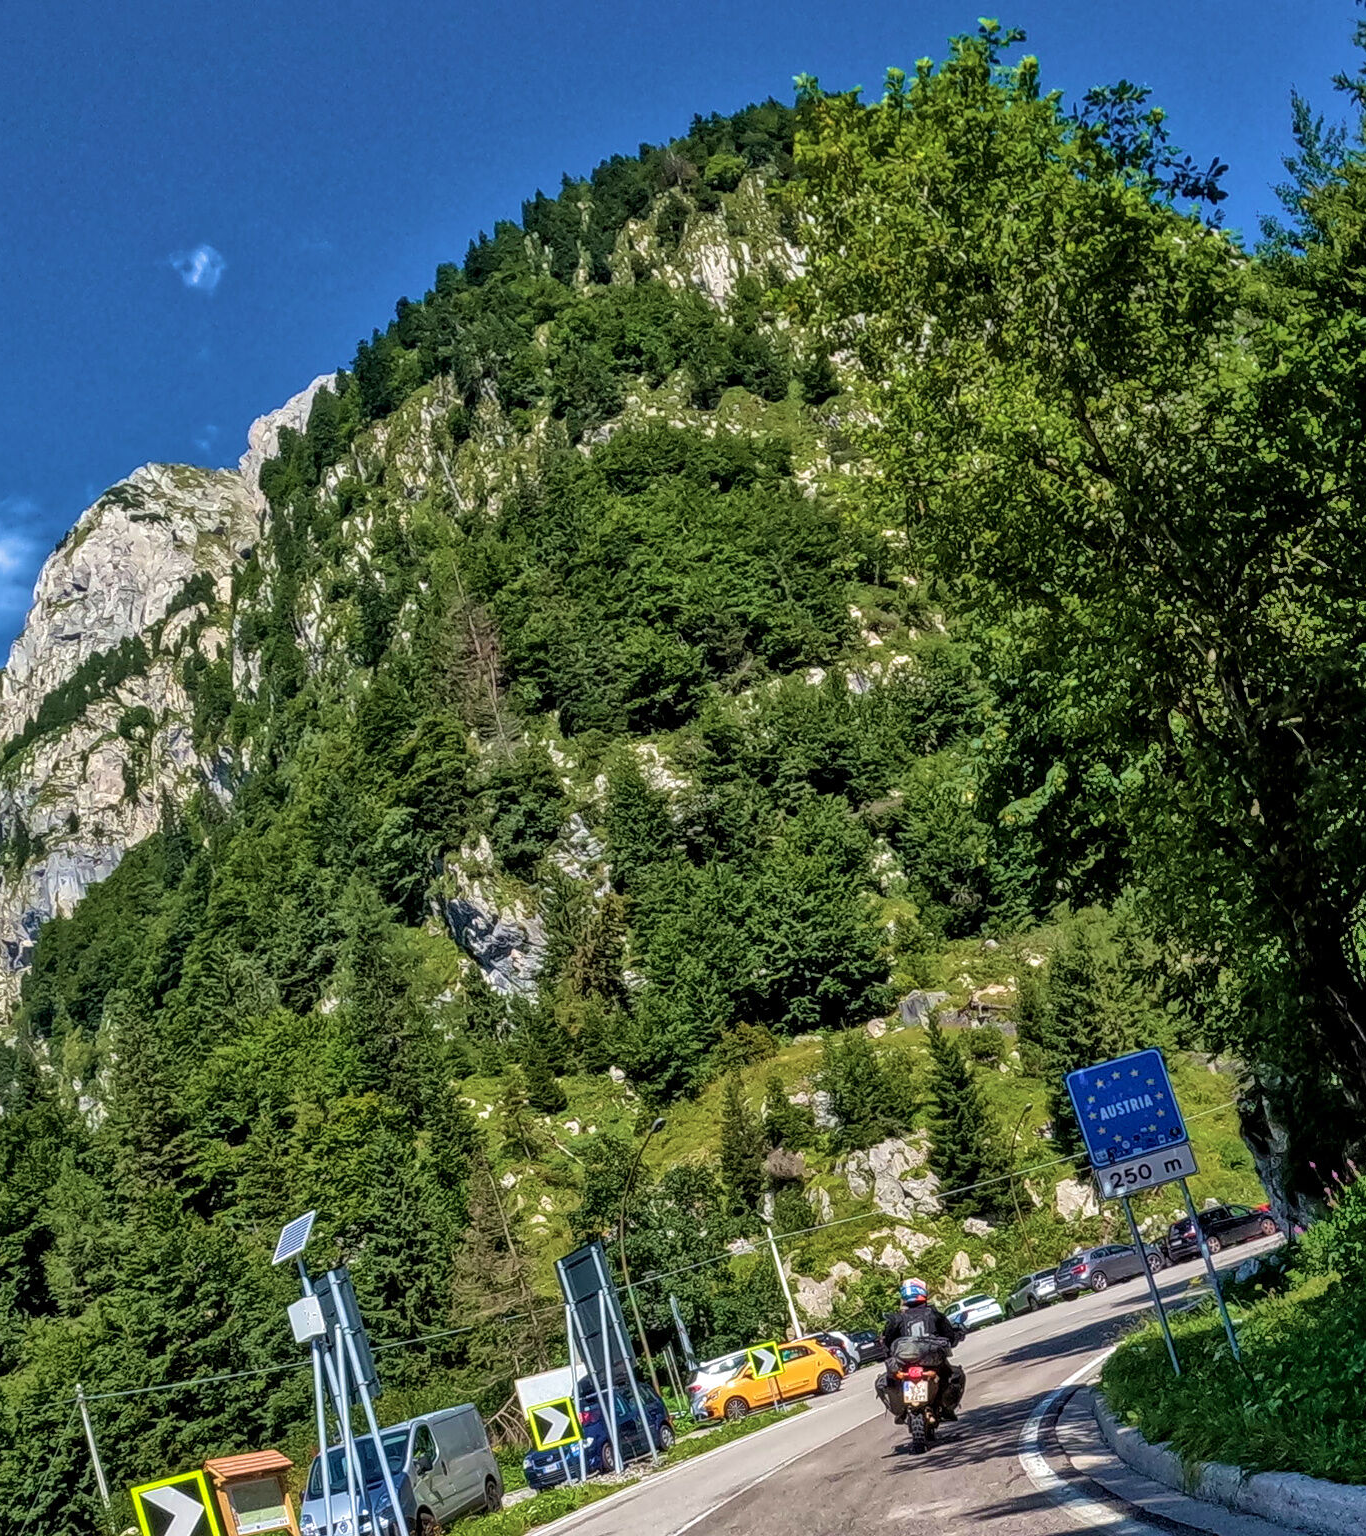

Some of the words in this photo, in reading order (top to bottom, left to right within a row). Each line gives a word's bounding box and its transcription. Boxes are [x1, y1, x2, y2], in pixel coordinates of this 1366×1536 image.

[1099, 1094, 1154, 1121] AUSTRIA
[1110, 1163, 1152, 1189] 250
[1164, 1157, 1182, 1174] m
